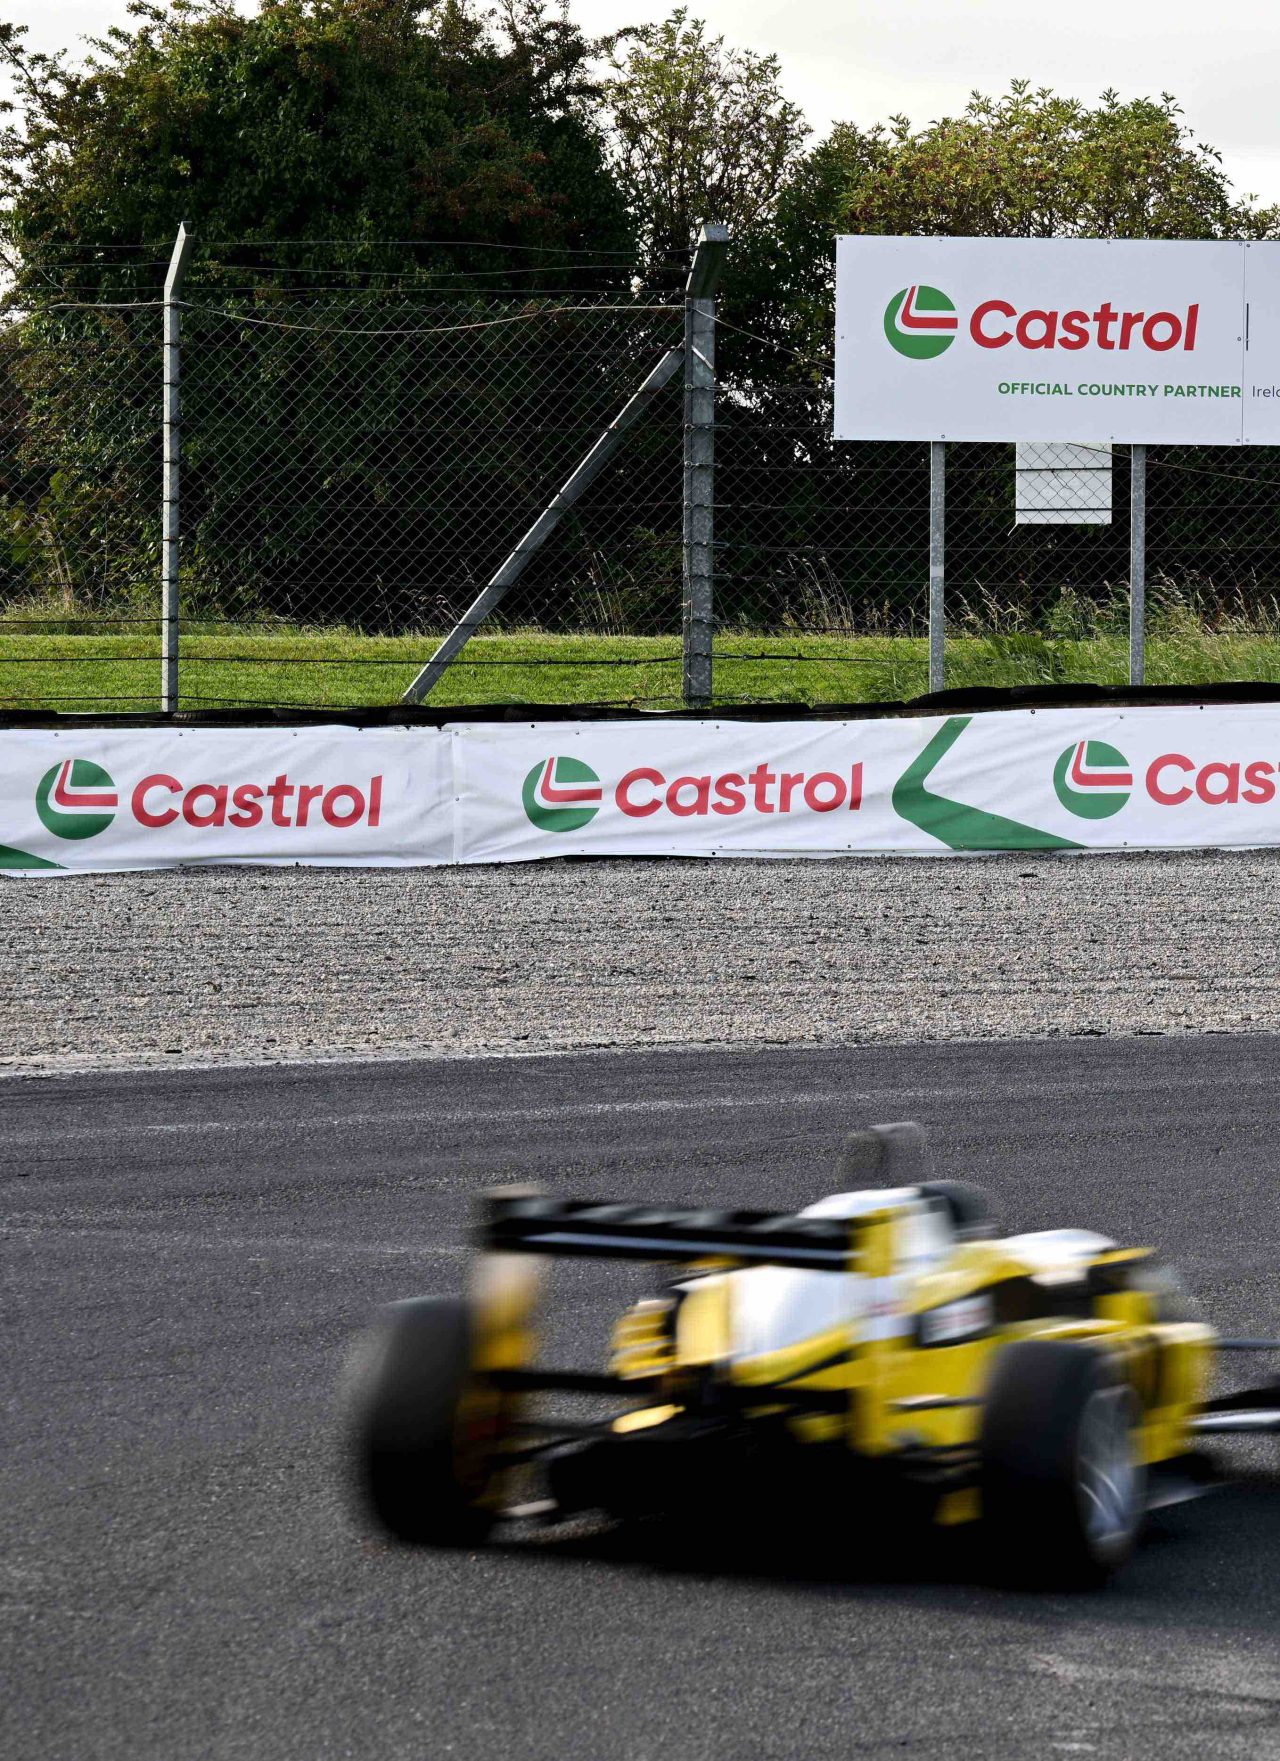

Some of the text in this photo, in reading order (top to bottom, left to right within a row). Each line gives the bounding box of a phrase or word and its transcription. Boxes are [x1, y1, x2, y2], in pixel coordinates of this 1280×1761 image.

[970, 299, 1199, 352] Castrol
[997, 382, 1073, 396] OFFICIAL
[1077, 383, 1159, 397] COUNTRY
[1163, 384, 1242, 398] PARTNER
[131, 774, 383, 828] Castrol
[615, 762, 863, 817] Castrol
